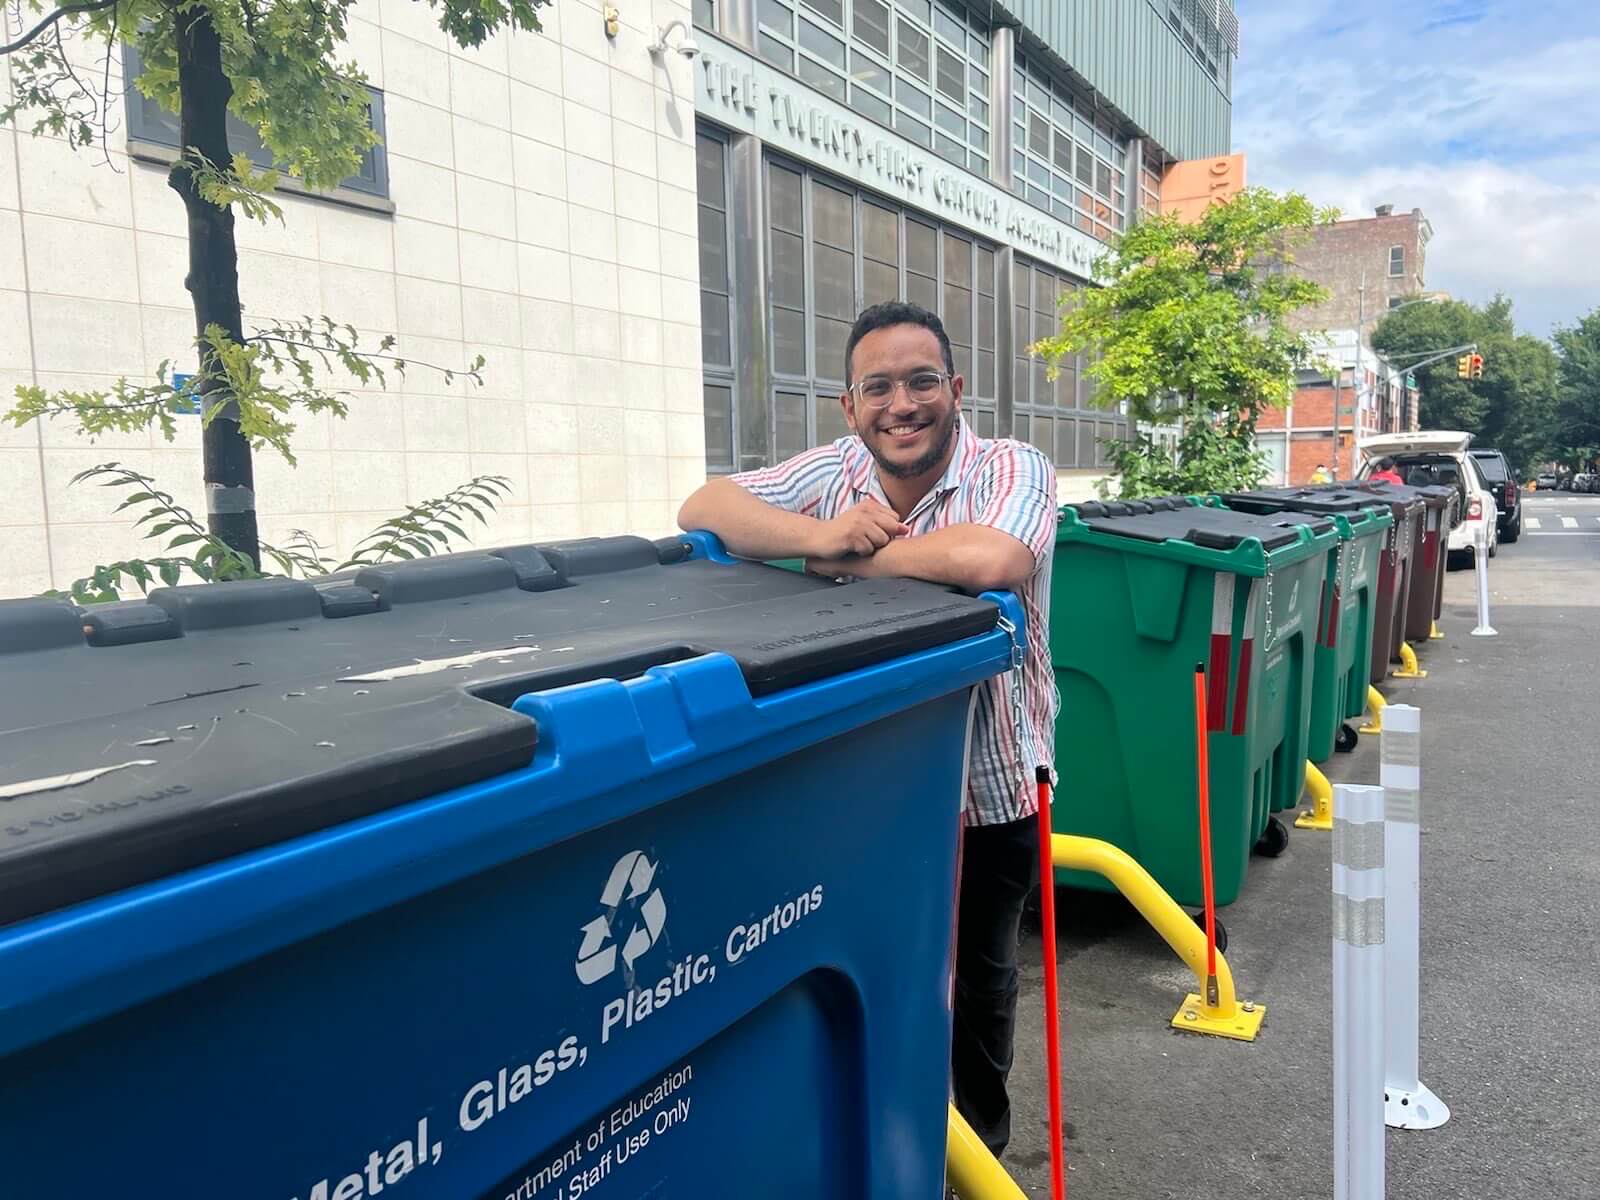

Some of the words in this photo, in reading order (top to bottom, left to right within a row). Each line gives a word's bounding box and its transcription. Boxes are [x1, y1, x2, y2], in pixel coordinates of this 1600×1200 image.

[702, 53, 758, 112] THE
[459, 1034, 589, 1132] Glass,
[601, 953, 716, 1044] Plastic,
[725, 884, 823, 963] Cartons
[568, 1151, 613, 1200] Staff
[616, 1128, 650, 1165] Use
[654, 1097, 691, 1136] Only
[587, 1120, 605, 1152] of
[610, 1064, 693, 1137] Education
